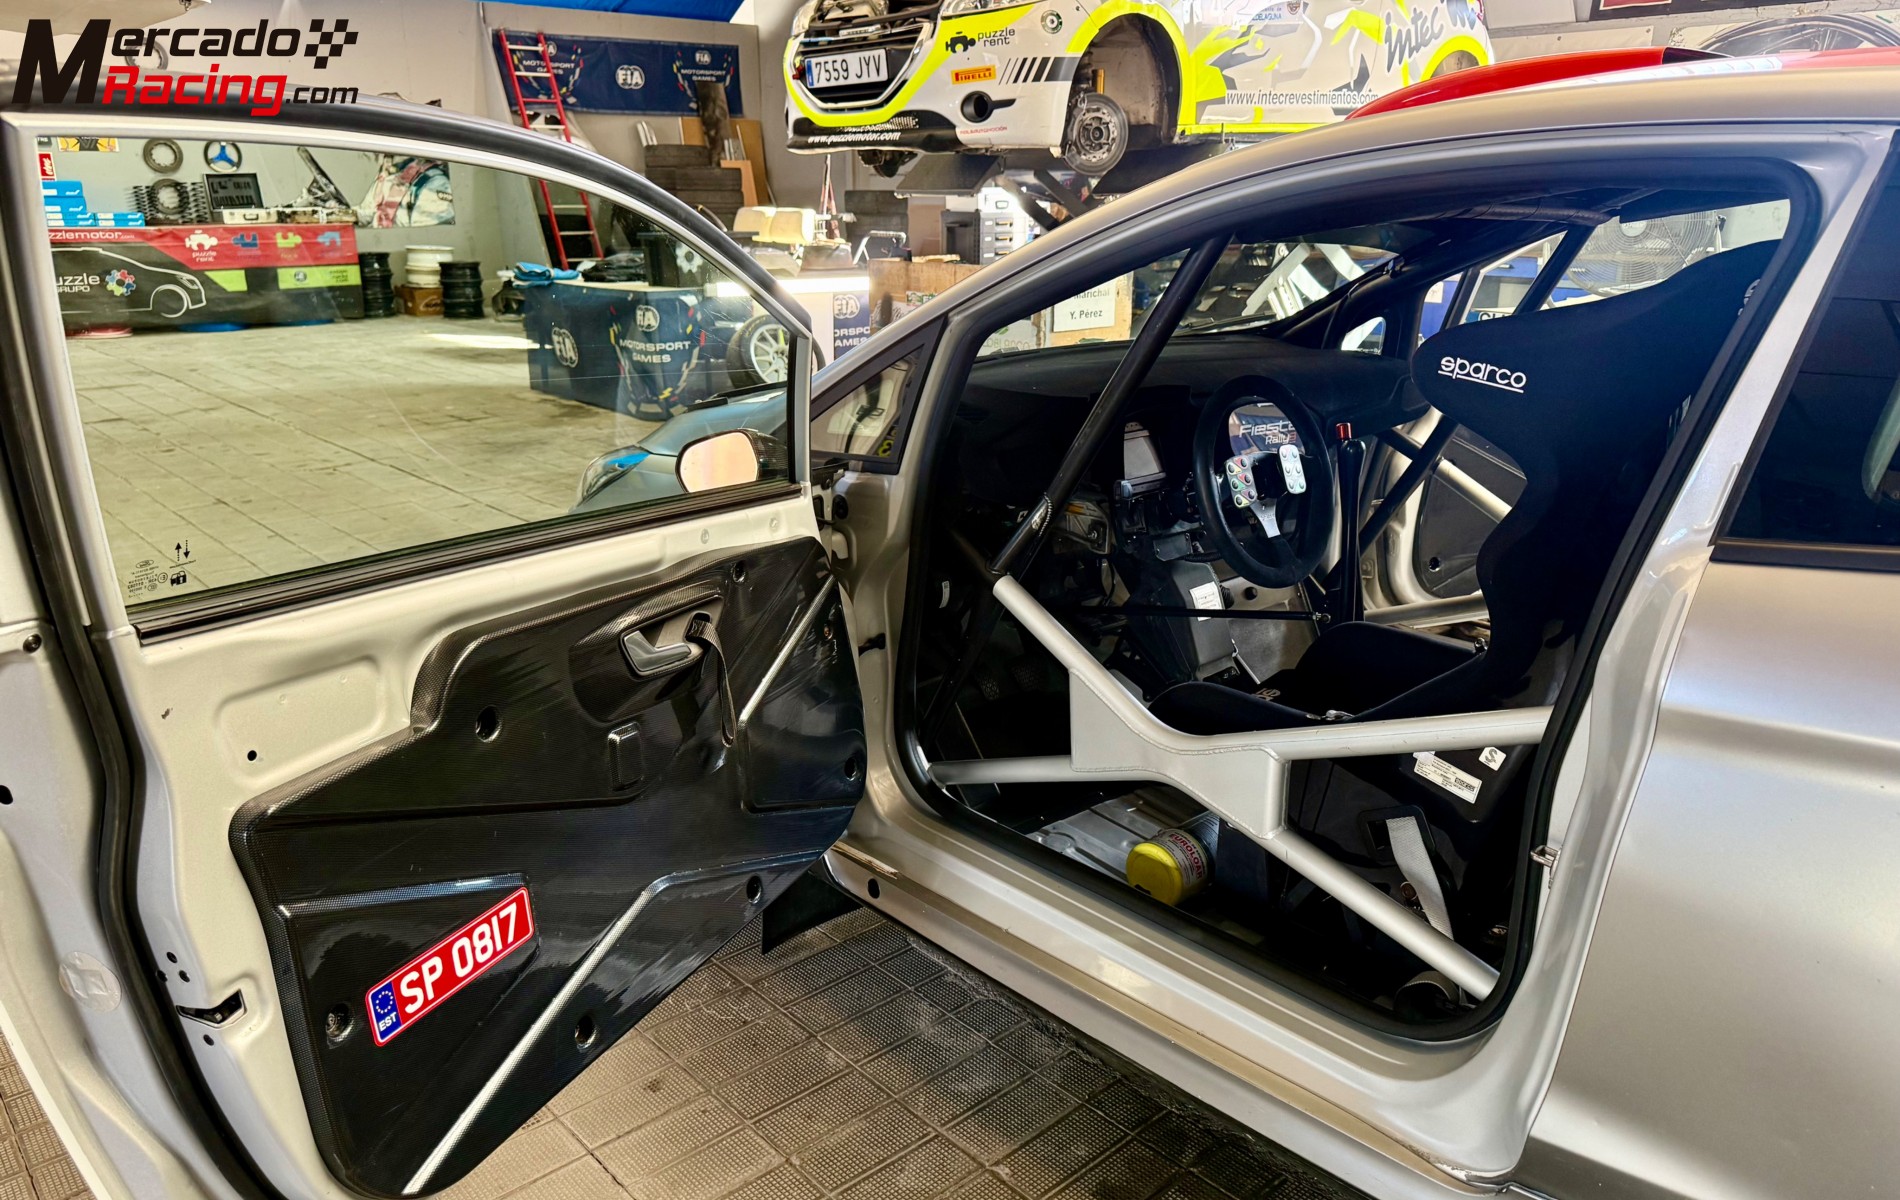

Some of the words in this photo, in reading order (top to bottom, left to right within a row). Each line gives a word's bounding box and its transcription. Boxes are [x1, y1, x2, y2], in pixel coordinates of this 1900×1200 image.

[977, 27, 1016, 41] puzzle
[983, 36, 1010, 47] rent
[522, 60, 575, 69] MOTOSPORT
[815, 59, 849, 83] 7559
[855, 54, 881, 79] JYV
[536, 67, 564, 75] GAES
[955, 68, 992, 81] PIRELLI
[1069, 311, 1077, 320] Y.
[1079, 308, 1103, 319] Pérez
[619, 340, 691, 352] MOTORSPORT
[632, 353, 672, 364] GAMES
[1440, 356, 1527, 389] sparco
[400, 956, 443, 1014] SP
[451, 901, 517, 978] 0817
[378, 1011, 397, 1031] EST
